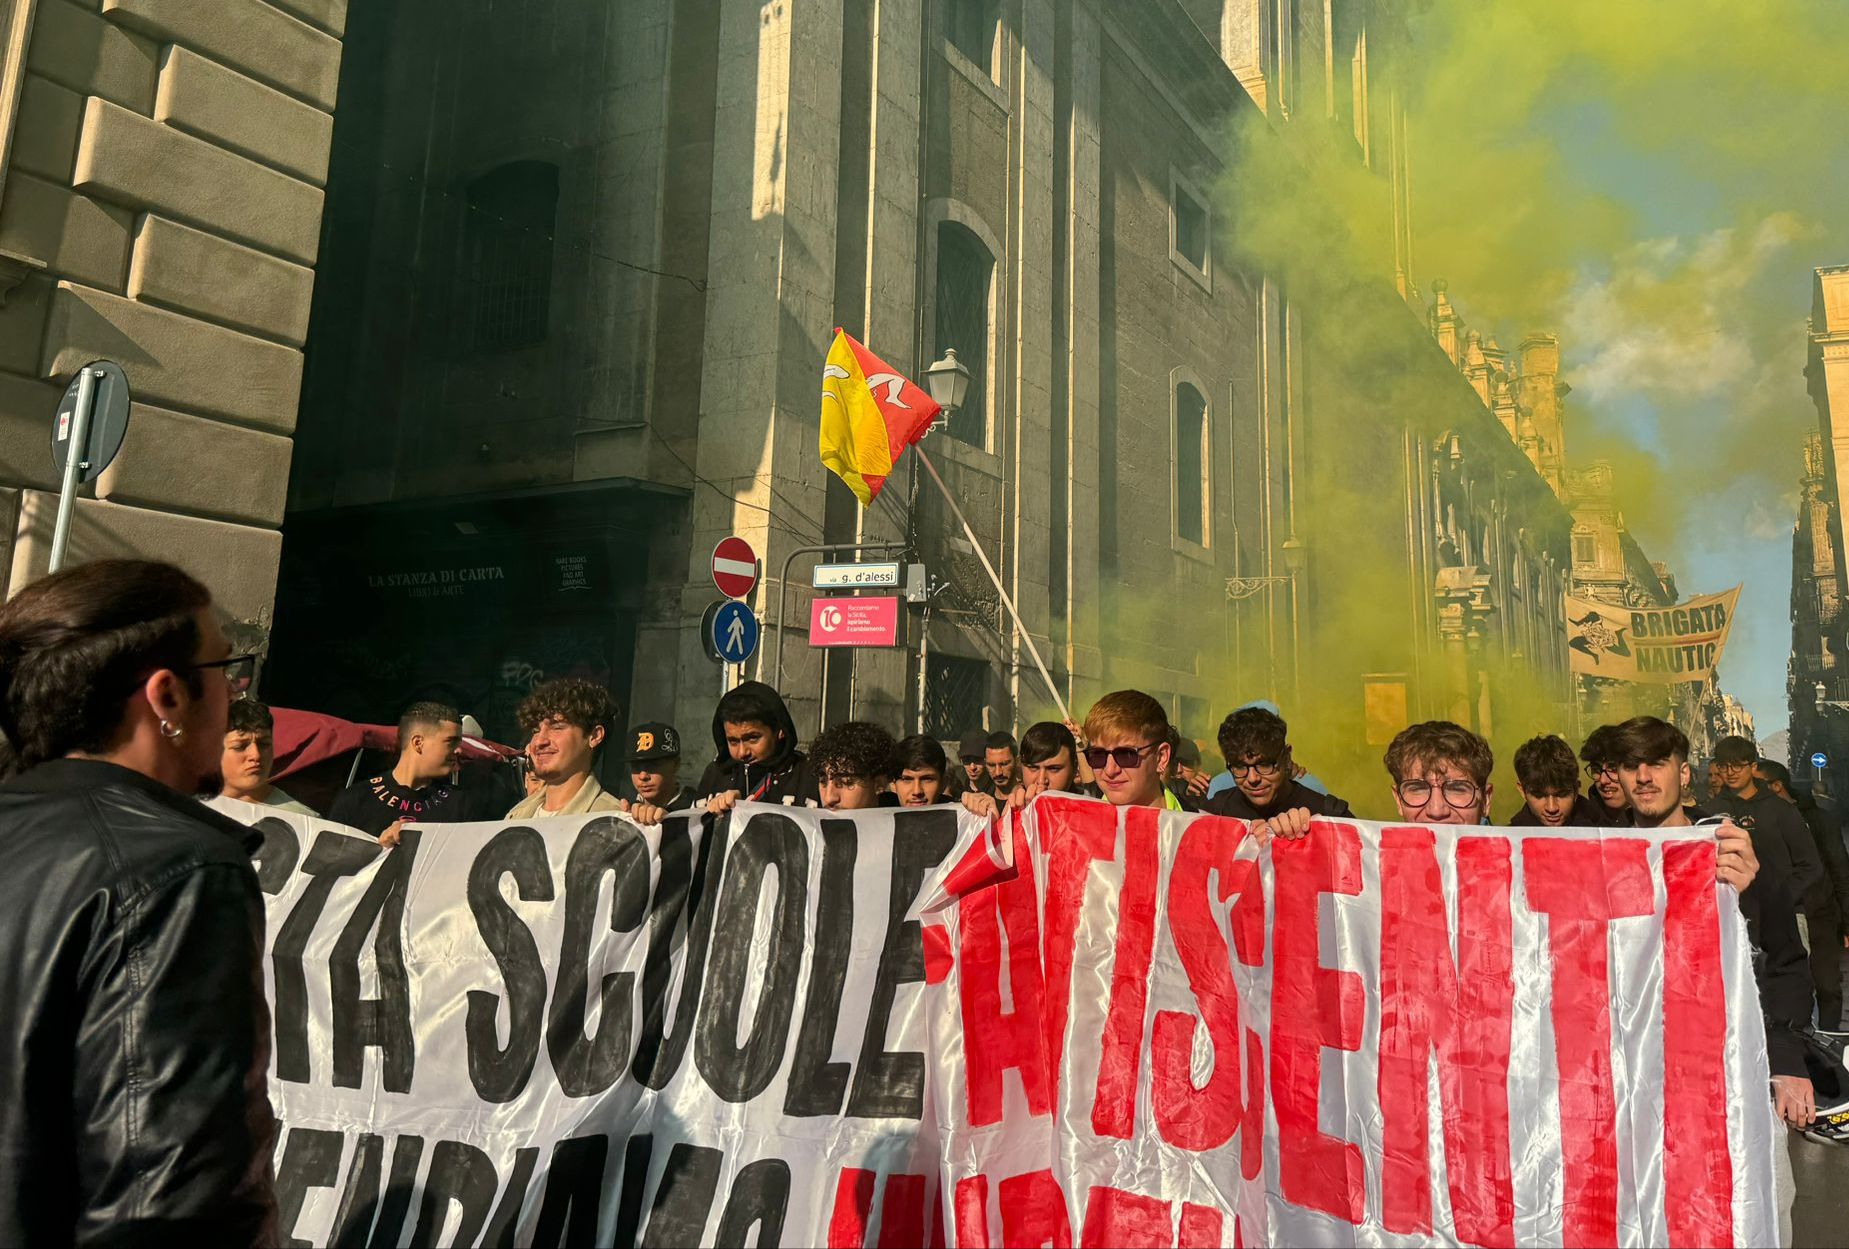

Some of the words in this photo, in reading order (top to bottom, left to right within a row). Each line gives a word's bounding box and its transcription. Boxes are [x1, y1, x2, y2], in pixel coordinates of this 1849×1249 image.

[368, 575, 385, 587] LA
[388, 572, 439, 586] STANZA
[440, 570, 455, 583] DI
[459, 566, 505, 581] CARTA
[841, 574, 852, 583] g.
[855, 571, 894, 582] d'alessi
[1630, 603, 1727, 638] BRIGATA
[467, 809, 959, 1121] SCUOLE
